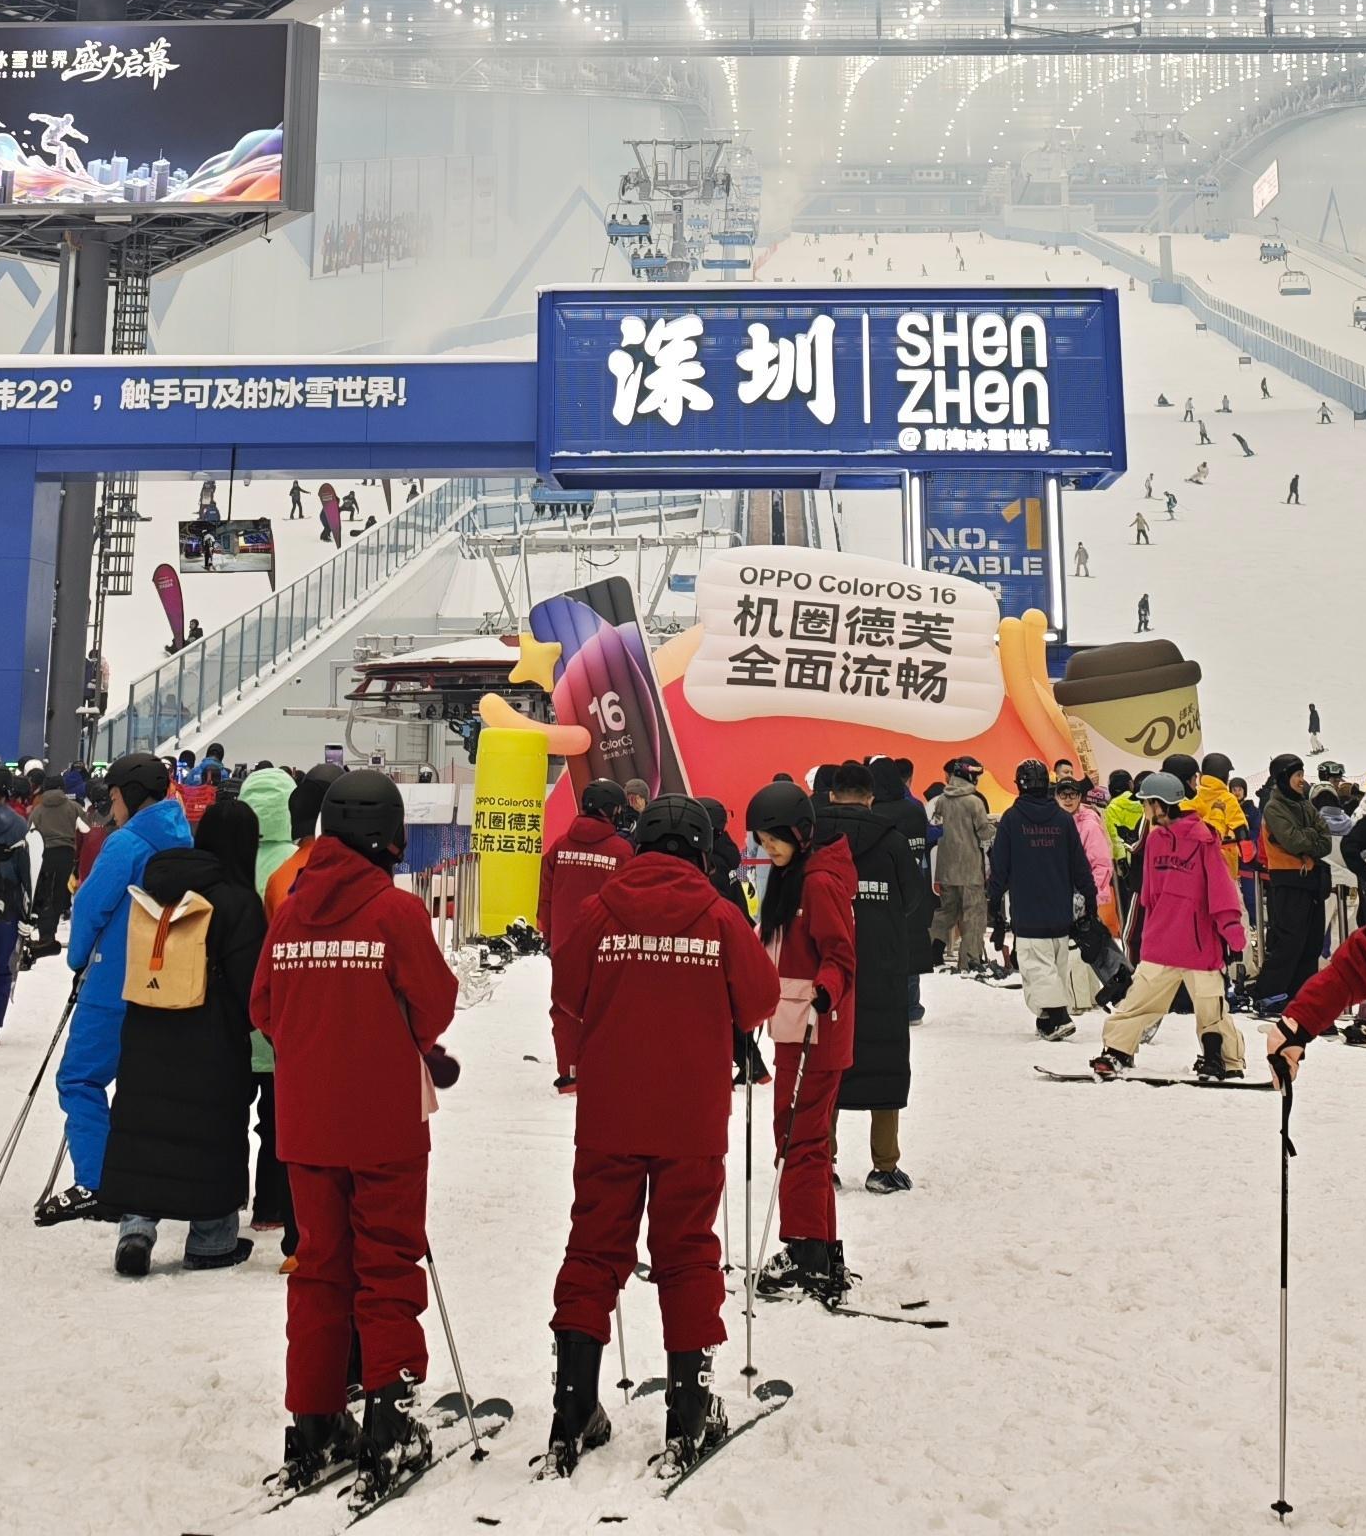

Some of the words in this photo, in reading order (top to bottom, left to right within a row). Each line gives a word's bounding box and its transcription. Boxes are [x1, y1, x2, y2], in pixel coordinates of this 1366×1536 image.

[61, 37, 181, 91] 盛大启幕
[608, 313, 836, 426] 深圳
[927, 527, 999, 550] NO.
[1001, 498, 1043, 551] 1
[739, 566, 813, 591] OPPO
[818, 574, 923, 603] ColorOS
[929, 586, 957, 605] 16
[928, 555, 1044, 576] CABLE
[733, 593, 955, 655] 机圈德芙
[726, 643, 948, 704] 全面流畅
[588, 690, 626, 735] 16
[475, 796, 496, 806] OPPO
[497, 797, 535, 808] ColorOS
[475, 810, 542, 833] 机圈德芙
[273, 960, 304, 971] HUAFA
[308, 960, 337, 969] SNOW
[342, 960, 384, 970] BONSKI
[597, 953, 633, 963] HUAFA
[637, 953, 671, 963] SNOW
[675, 954, 720, 967] BONSKI
